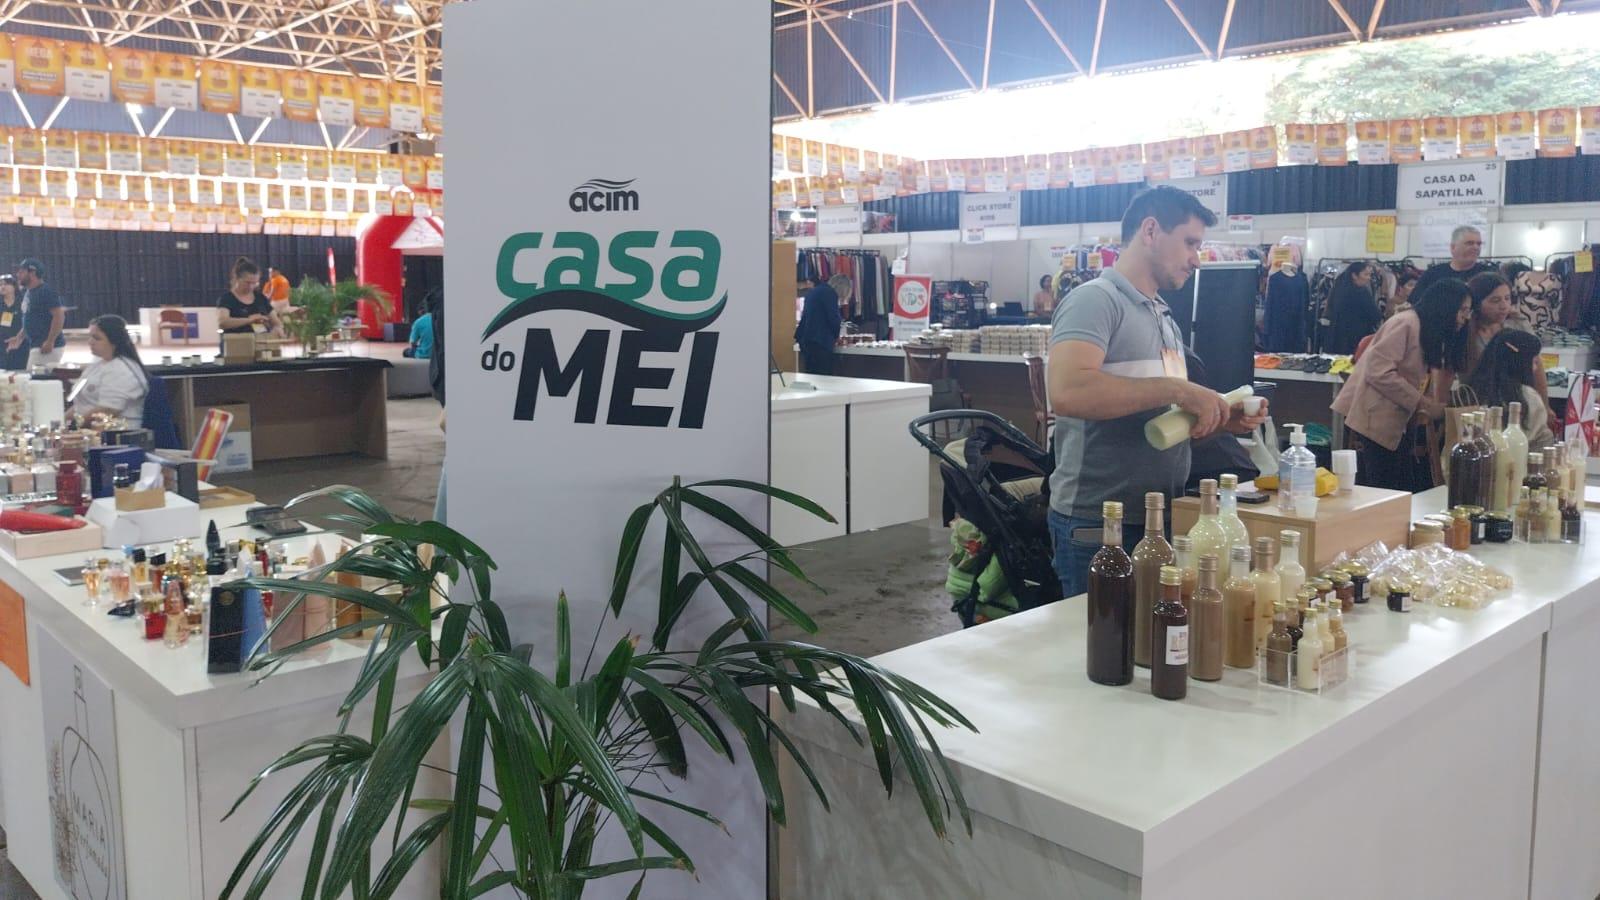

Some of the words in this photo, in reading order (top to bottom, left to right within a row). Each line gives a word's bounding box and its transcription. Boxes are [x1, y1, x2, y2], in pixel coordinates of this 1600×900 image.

[1485, 163, 1497, 171] 25
[1423, 174, 1456, 185] CASA
[1459, 173, 1476, 183] DA
[568, 189, 640, 213] acim
[1415, 187, 1484, 199] SAPATILHA
[496, 230, 722, 302] casa
[480, 343, 516, 372] do
[513, 327, 720, 429] MEI
